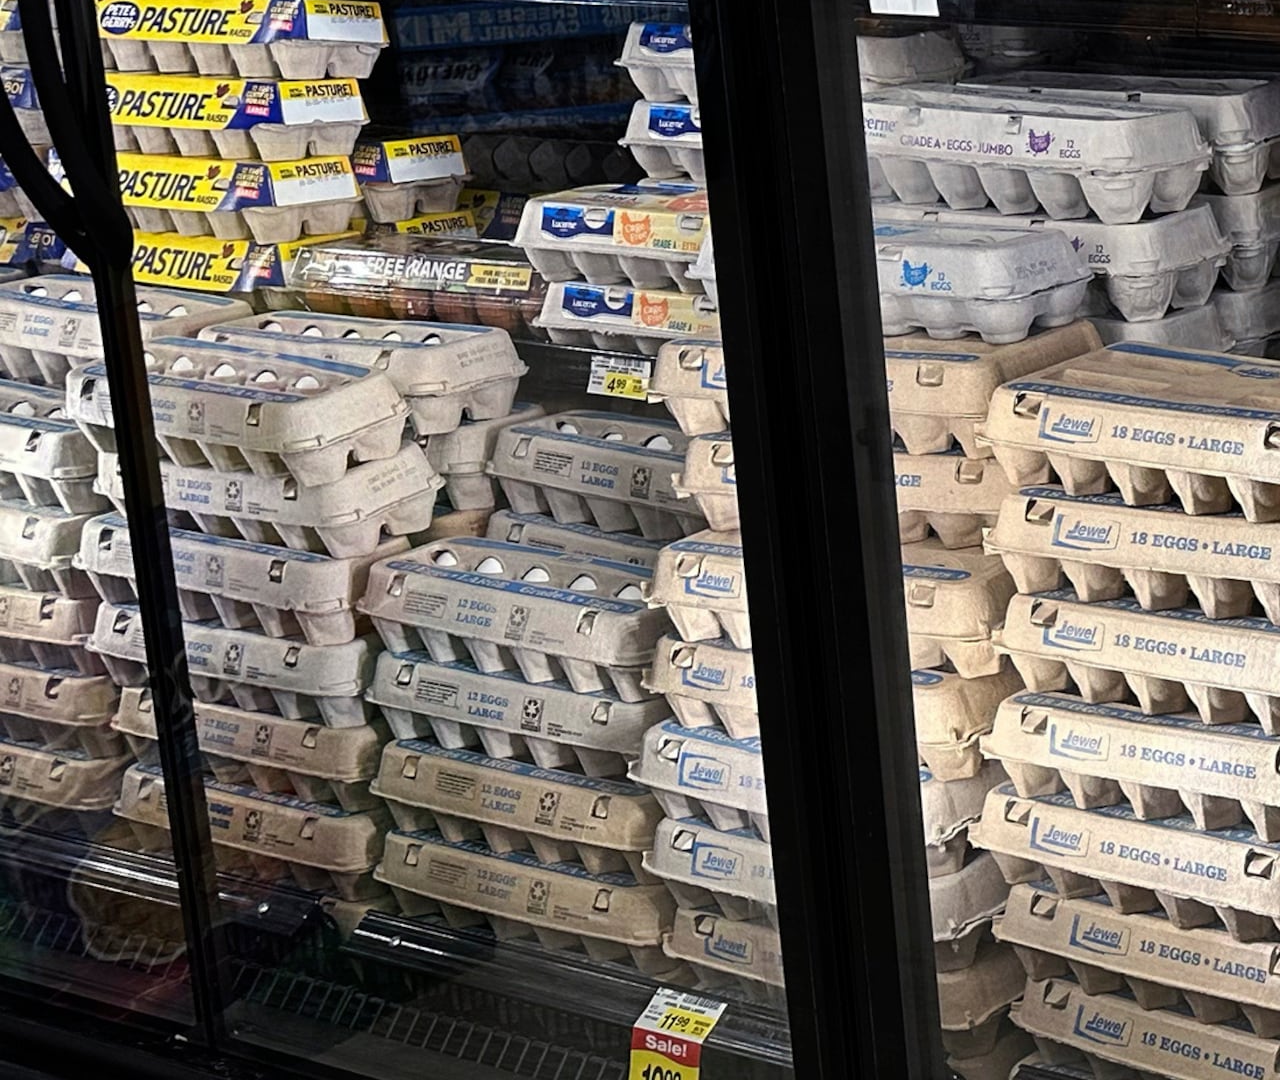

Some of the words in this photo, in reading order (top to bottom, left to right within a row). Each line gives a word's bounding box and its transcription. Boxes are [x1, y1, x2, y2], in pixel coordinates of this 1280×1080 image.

[137, 6, 230, 36] PASTURE
[900, 134, 931, 148] GRADE
[946, 139, 972, 152] EGGS
[977, 142, 1013, 156] JUMBO
[653, 238, 671, 249] GRADE
[367, 255, 403, 275] FREE
[406, 259, 466, 281] RANGE
[1055, 414, 1095, 434] Jewel
[1111, 425, 1128, 439] 18
[1131, 428, 1175, 446] EGGS
[1188, 436, 1245, 456] LARGE
[458, 600, 472, 611] 12
[475, 597, 498, 615] EGGS
[455, 611, 492, 629] LARGE
[699, 761, 725, 782] Jewel
[645, 1035, 689, 1057] Sale!
